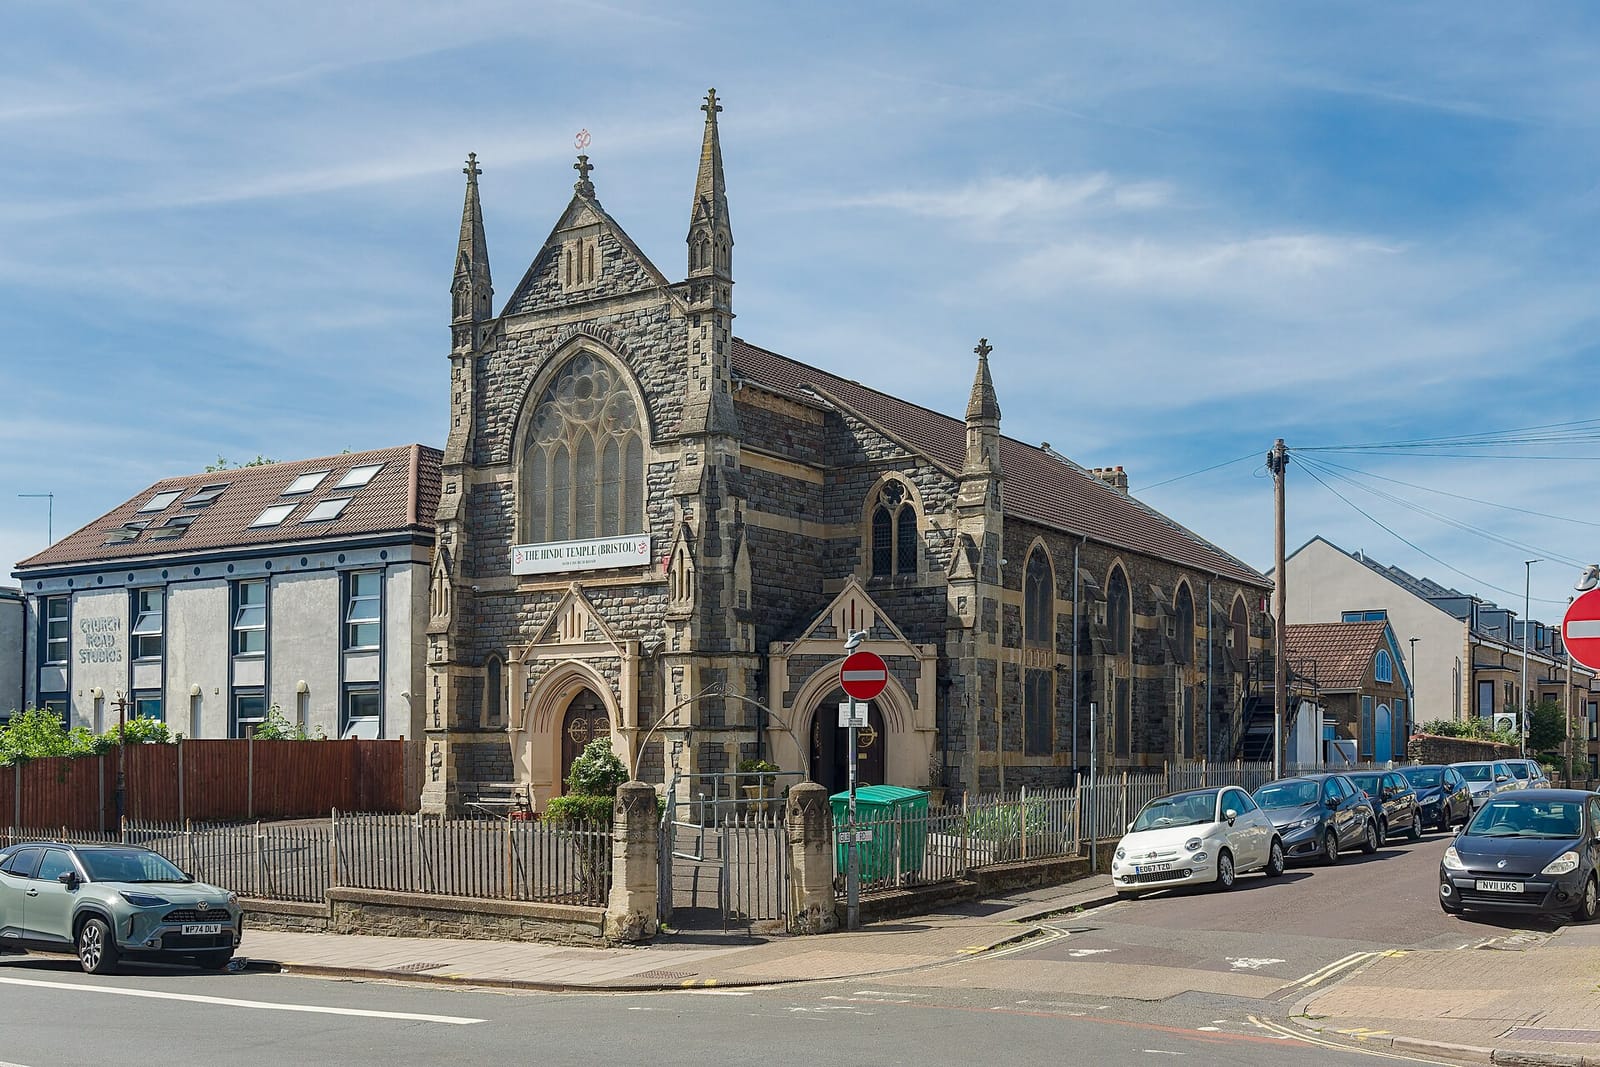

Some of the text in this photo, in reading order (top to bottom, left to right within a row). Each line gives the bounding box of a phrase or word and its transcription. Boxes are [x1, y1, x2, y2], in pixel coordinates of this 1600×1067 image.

[524, 541, 637, 561] THE HINDU TEMPLE (BRISTOL)
[80, 616, 121, 633] CHURCH
[86, 632, 115, 648] ROAD
[79, 648, 122, 664] STUDIOS
[1500, 882, 1517, 891] UKS
[185, 925, 203, 934] WP74
